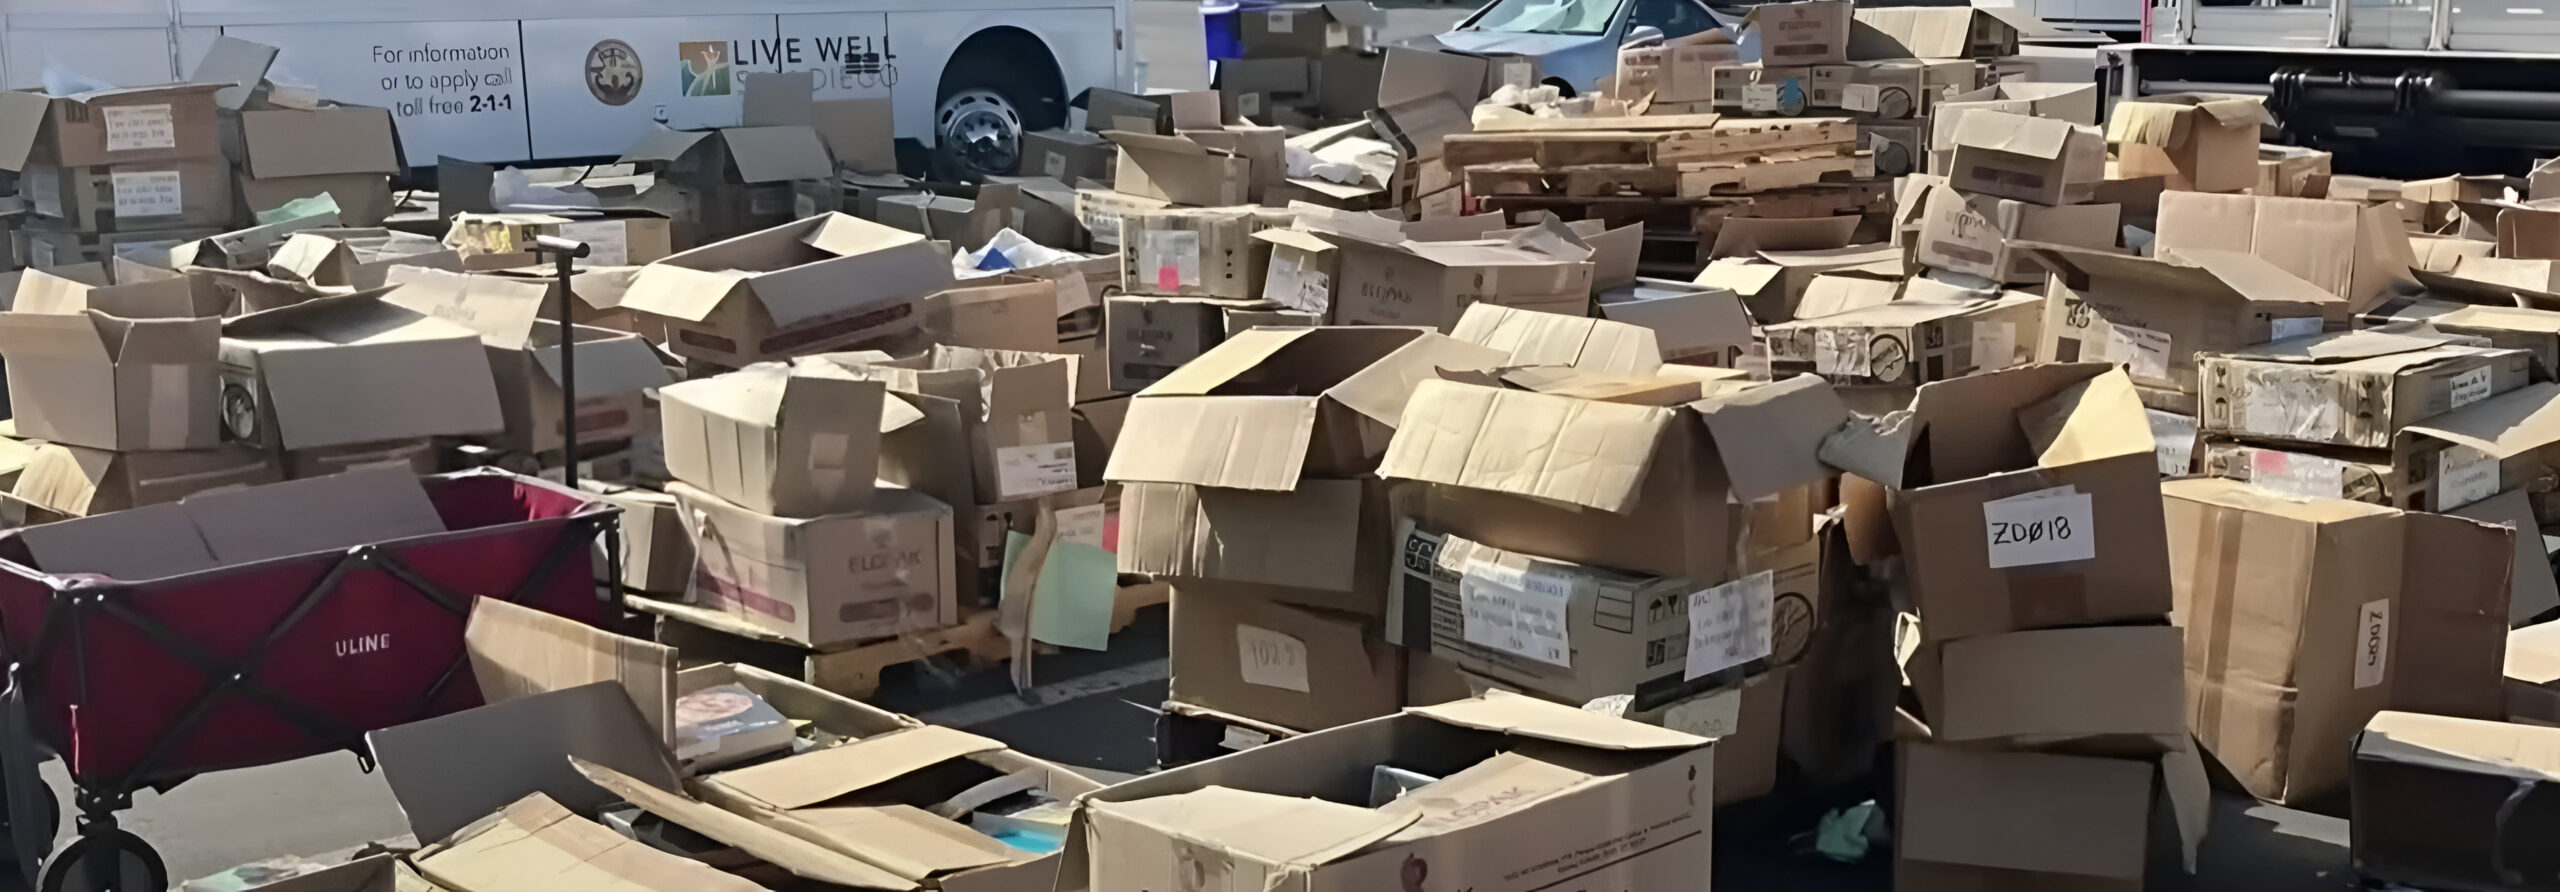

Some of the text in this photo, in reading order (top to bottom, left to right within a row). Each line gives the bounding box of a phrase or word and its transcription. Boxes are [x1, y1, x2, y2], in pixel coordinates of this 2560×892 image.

[373, 42, 509, 63] For information
[734, 35, 896, 65] LIVE WELL
[381, 75, 398, 91] or
[405, 75, 424, 90] to
[430, 69, 479, 93] apply
[396, 93, 512, 117] toll free 2-1-1
[336, 633, 390, 656] ULINE
